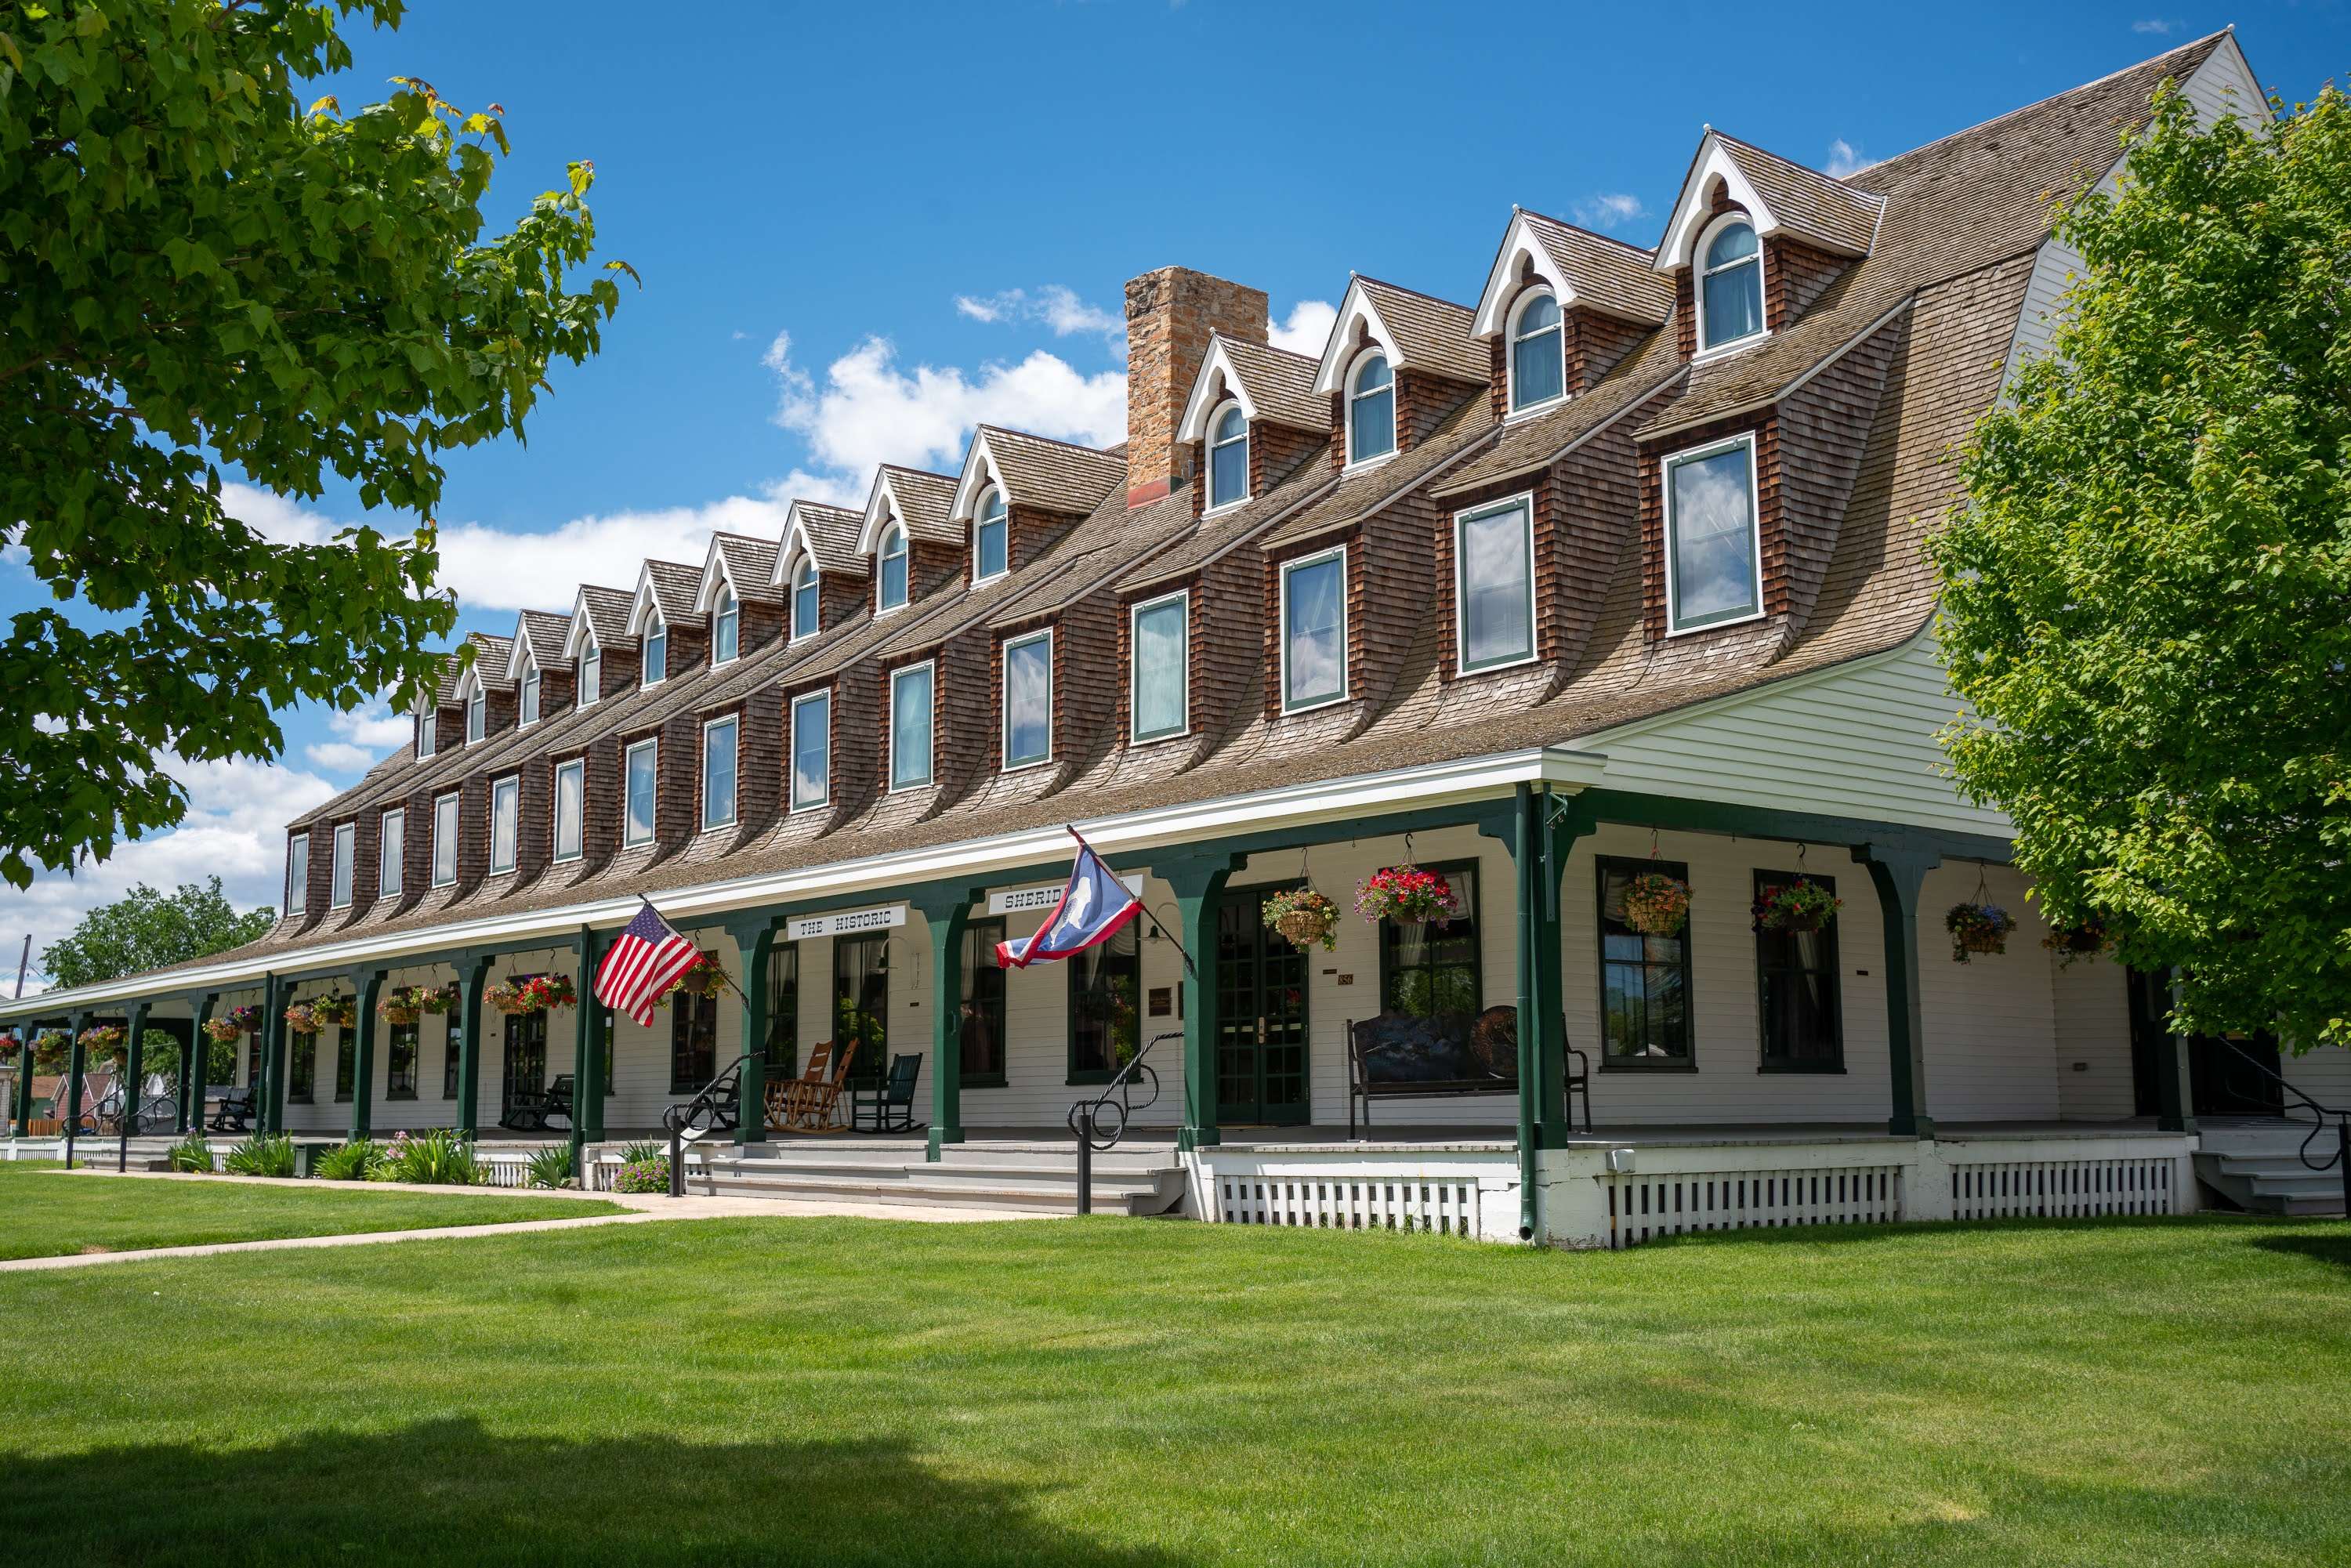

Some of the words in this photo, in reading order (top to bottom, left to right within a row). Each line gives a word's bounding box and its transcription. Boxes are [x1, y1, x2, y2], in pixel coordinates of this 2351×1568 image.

[1005, 888, 1068, 908] SHERID
[800, 921, 823, 935] THE
[835, 911, 891, 930] HISTORIC
[1339, 975, 1353, 985] 856
